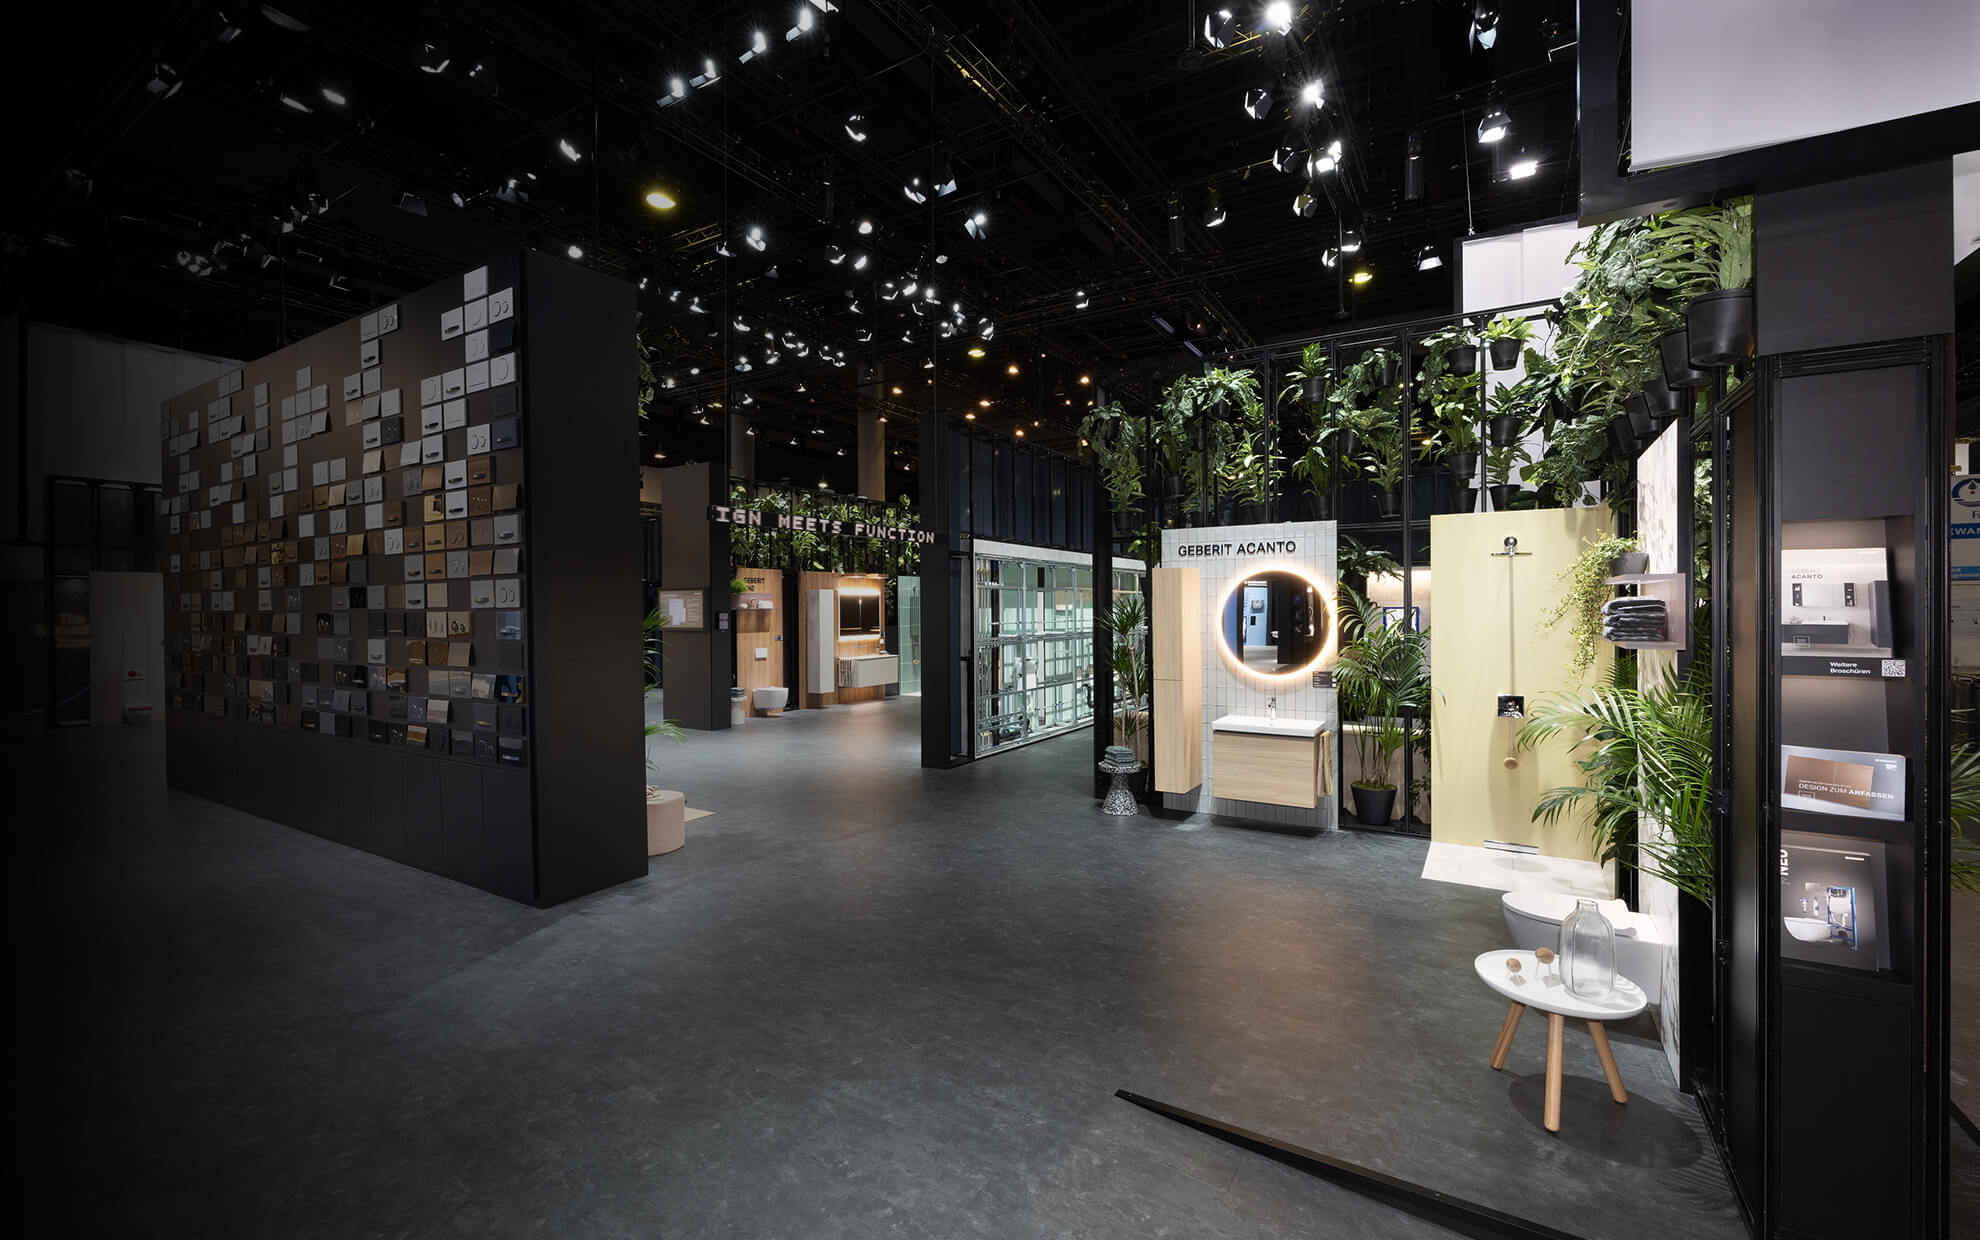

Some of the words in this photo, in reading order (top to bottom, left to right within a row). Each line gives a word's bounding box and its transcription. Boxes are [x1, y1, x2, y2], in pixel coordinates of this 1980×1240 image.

[712, 506, 762, 527] IGN
[778, 514, 842, 534] MEETS
[854, 523, 935, 544] FUNCTION
[1178, 543, 1233, 557] GEBERIT
[1236, 541, 1297, 555] ACANTO
[1829, 667, 1871, 675] Broschüren
[1798, 783, 1828, 792] DESIGN
[1829, 786, 1848, 794] ZUM
[1848, 789, 1895, 800] ANFASSEN
